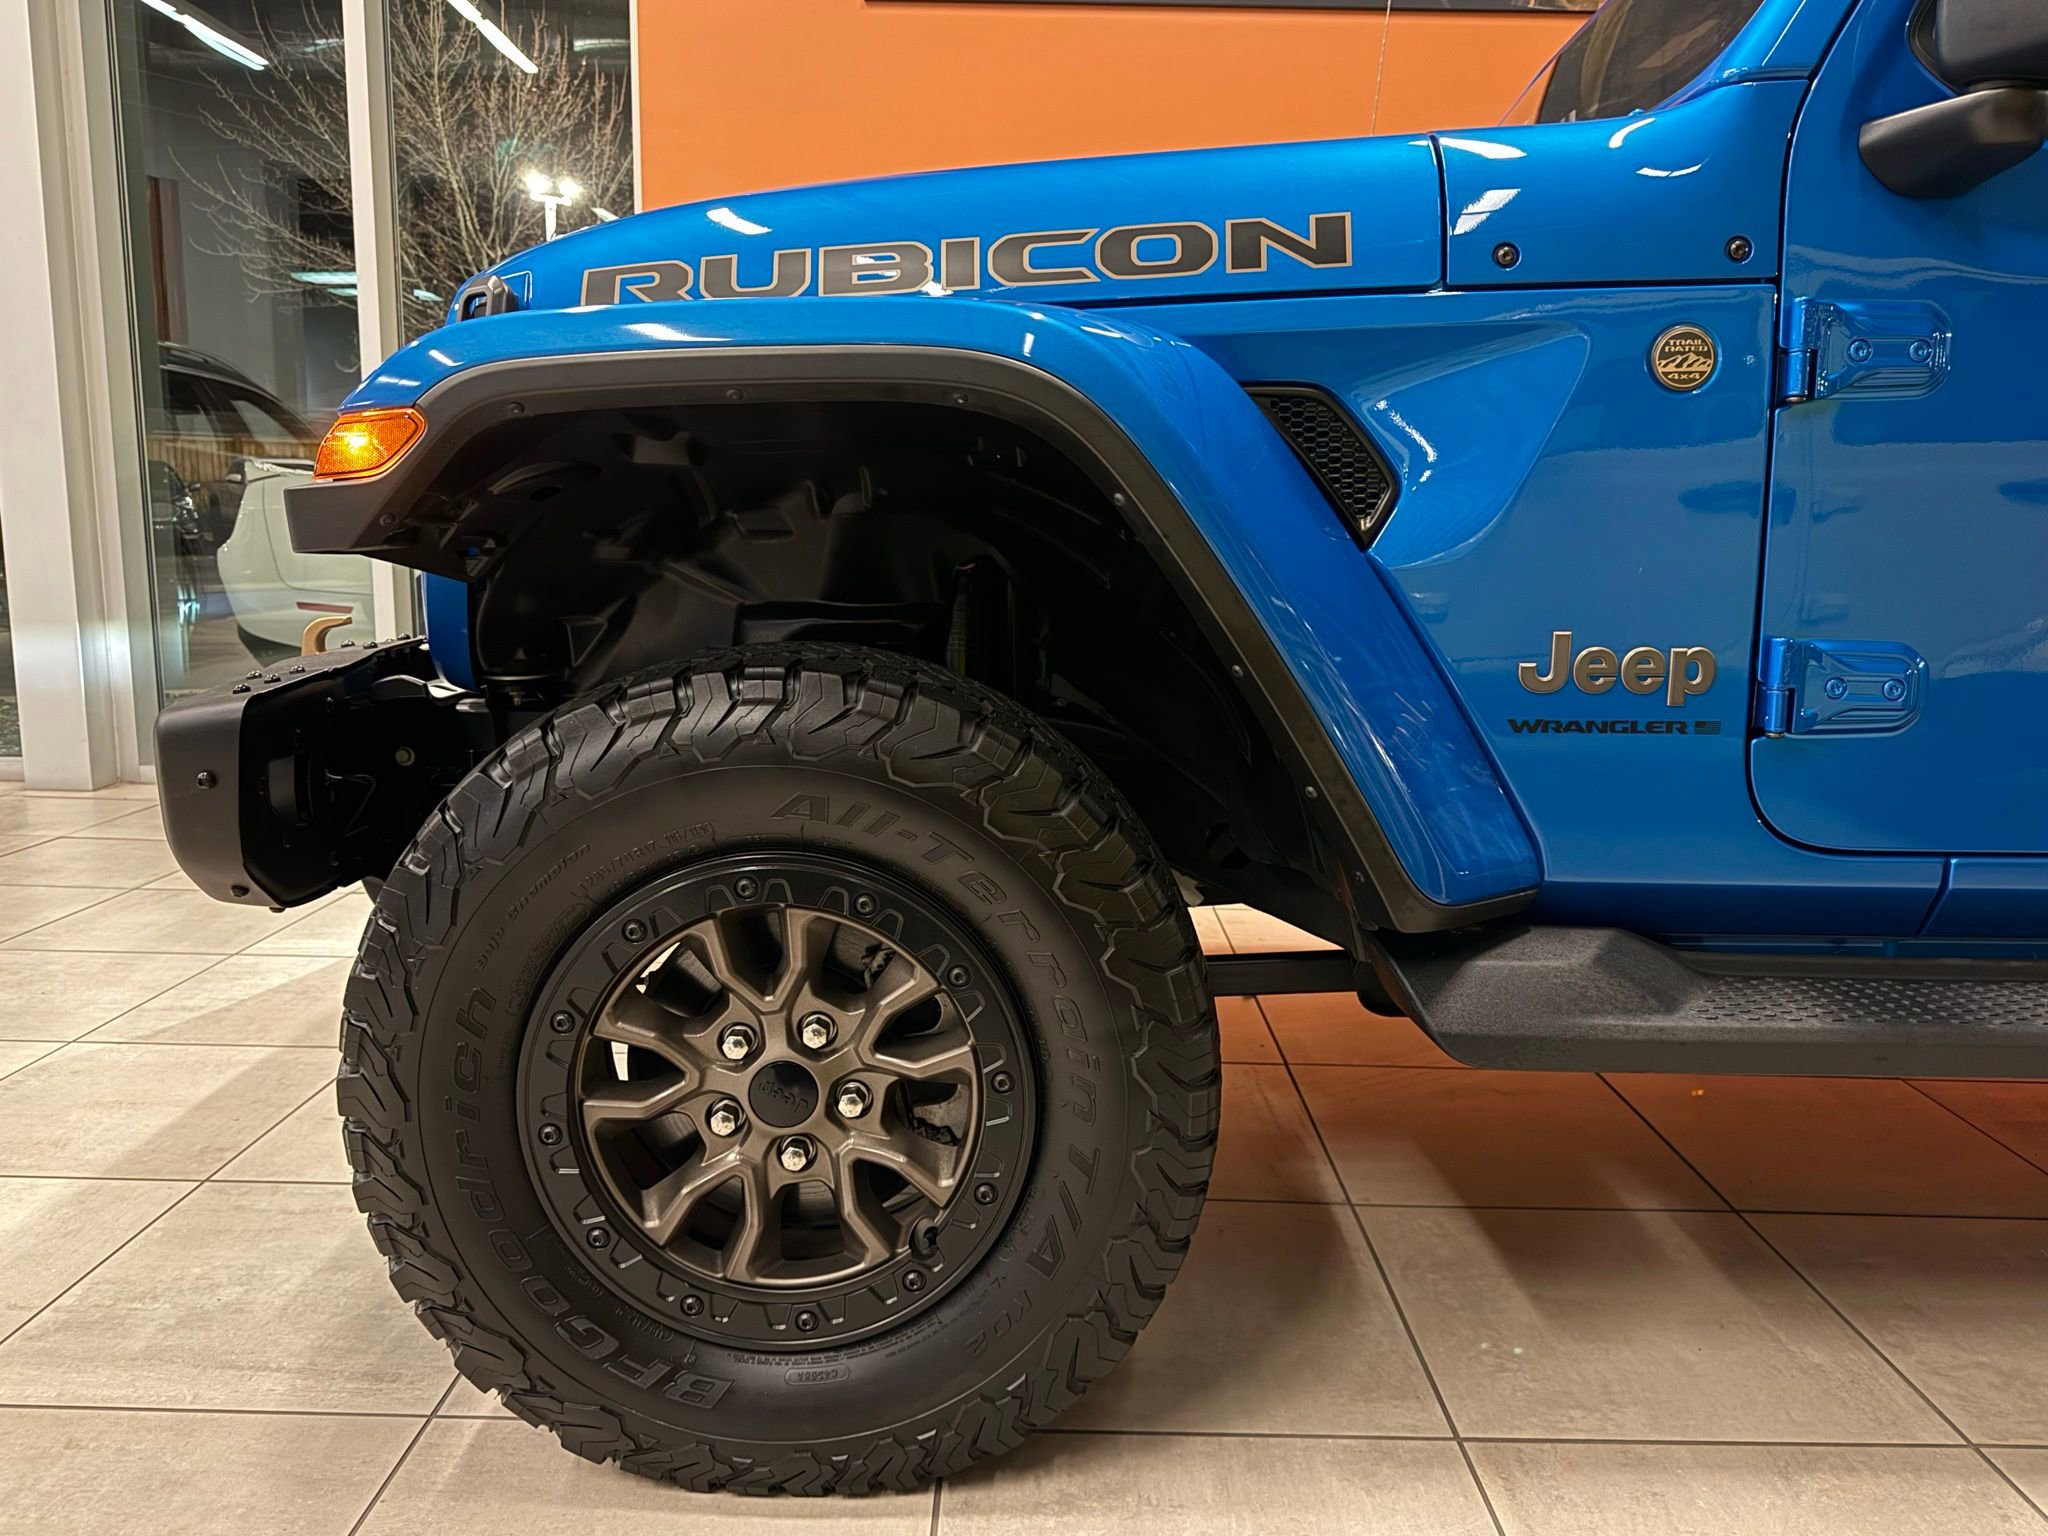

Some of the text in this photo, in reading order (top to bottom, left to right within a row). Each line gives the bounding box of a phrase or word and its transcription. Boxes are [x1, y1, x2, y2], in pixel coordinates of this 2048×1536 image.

[581, 211, 1353, 306] RUBICON
[1664, 345, 1708, 353] RATED
[1667, 338, 1703, 346] TRAIL
[1667, 372, 1701, 380] 4x4
[1518, 630, 1717, 706] Jeep
[1506, 718, 1688, 735] WRANGLER
[444, 985, 735, 1410] BFGoodrich
